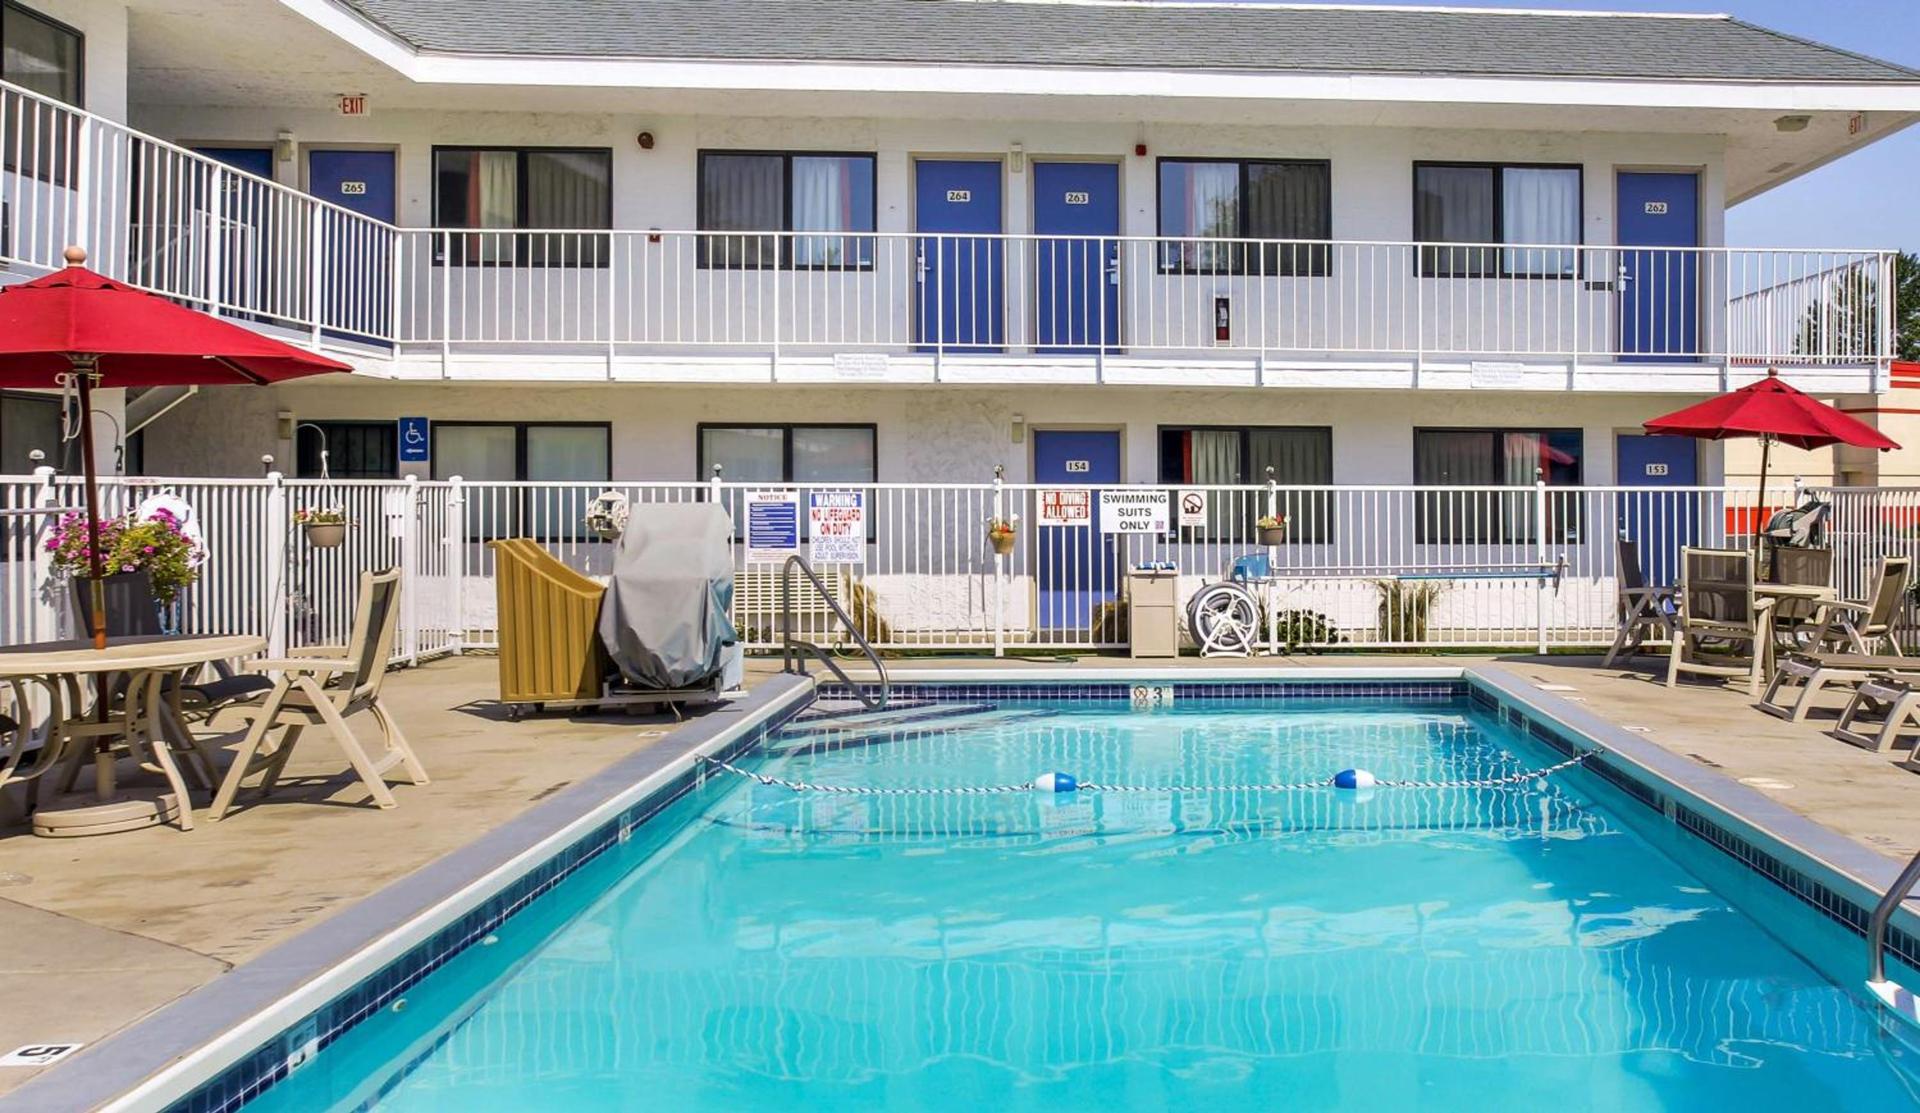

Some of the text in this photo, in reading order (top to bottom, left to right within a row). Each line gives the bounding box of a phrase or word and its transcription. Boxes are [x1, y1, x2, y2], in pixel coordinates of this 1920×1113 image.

[342, 97, 364, 114] EXIT
[344, 183, 363, 193] 265
[949, 191, 968, 201] 264
[1068, 193, 1086, 203] 263
[1647, 203, 1665, 213] 262
[1068, 461, 1086, 471] 154
[1648, 465, 1665, 474] 153
[814, 493, 858, 507] WARNING
[1046, 492, 1057, 504] NO
[1102, 494, 1167, 504] SWIMMING
[812, 509, 861, 521] NO LIFEGUARD
[1046, 505, 1086, 518] ALLOWED
[1117, 507, 1152, 517] SUITS
[820, 522, 852, 535] ON DUTY
[1119, 520, 1150, 530] ONLY
